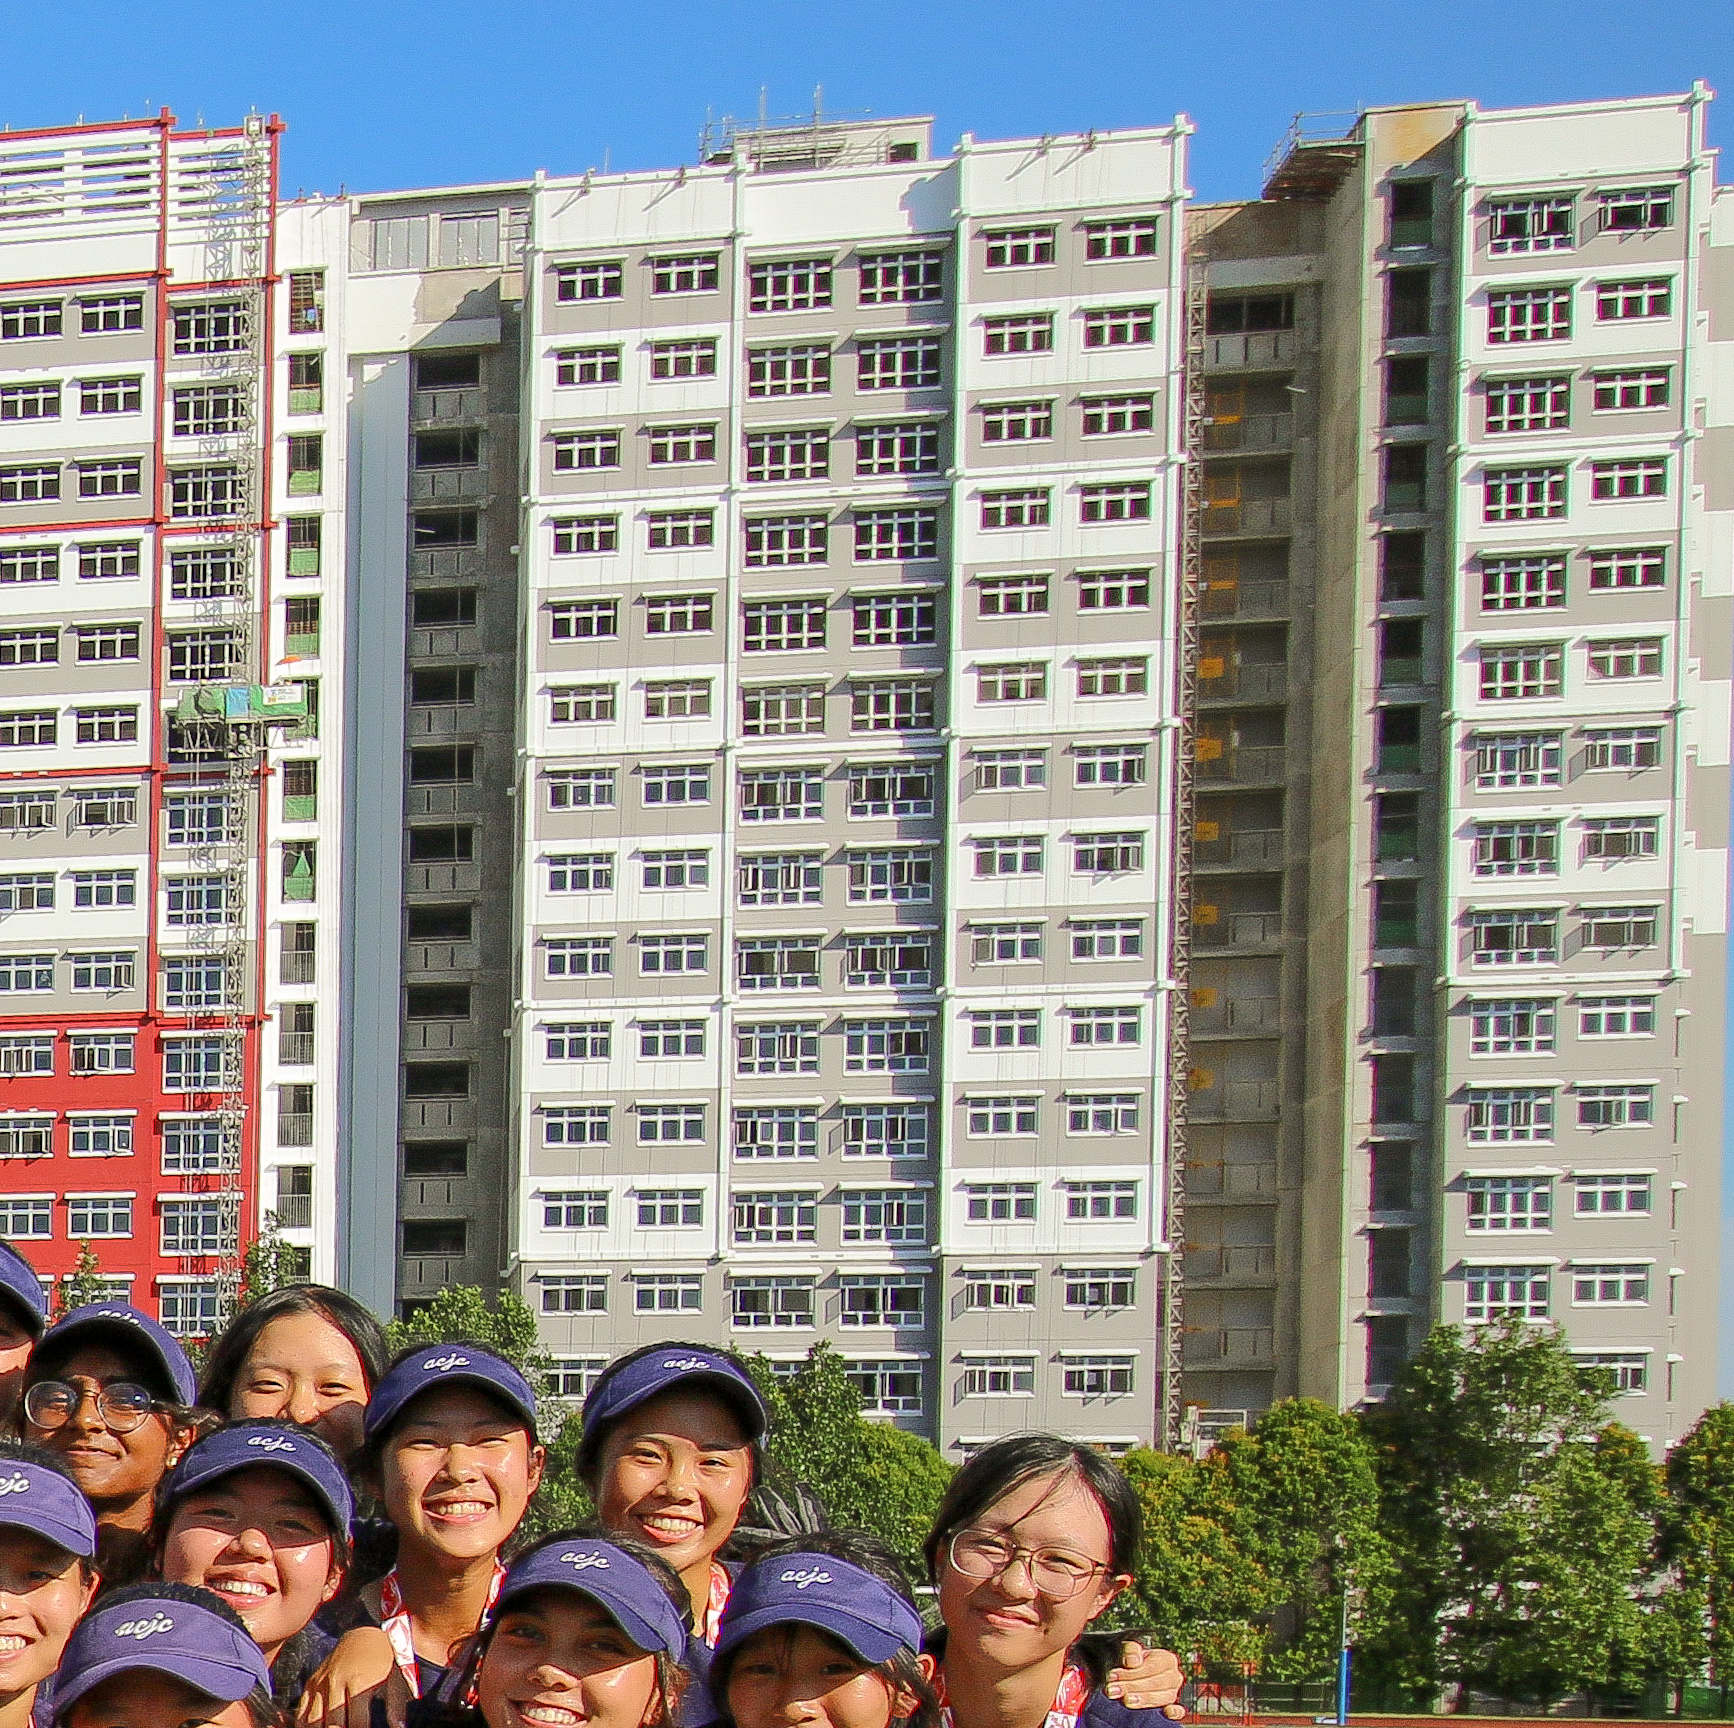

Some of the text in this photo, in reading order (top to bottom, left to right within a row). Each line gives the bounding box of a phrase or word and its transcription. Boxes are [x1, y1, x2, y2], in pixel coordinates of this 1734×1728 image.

[423, 1352, 471, 1372] acjc
[662, 1356, 710, 1371] acjc
[248, 1436, 296, 1451] acjc
[560, 1548, 610, 1570] acjc
[780, 1566, 833, 1589] acjc
[114, 1611, 174, 1640] acjc
